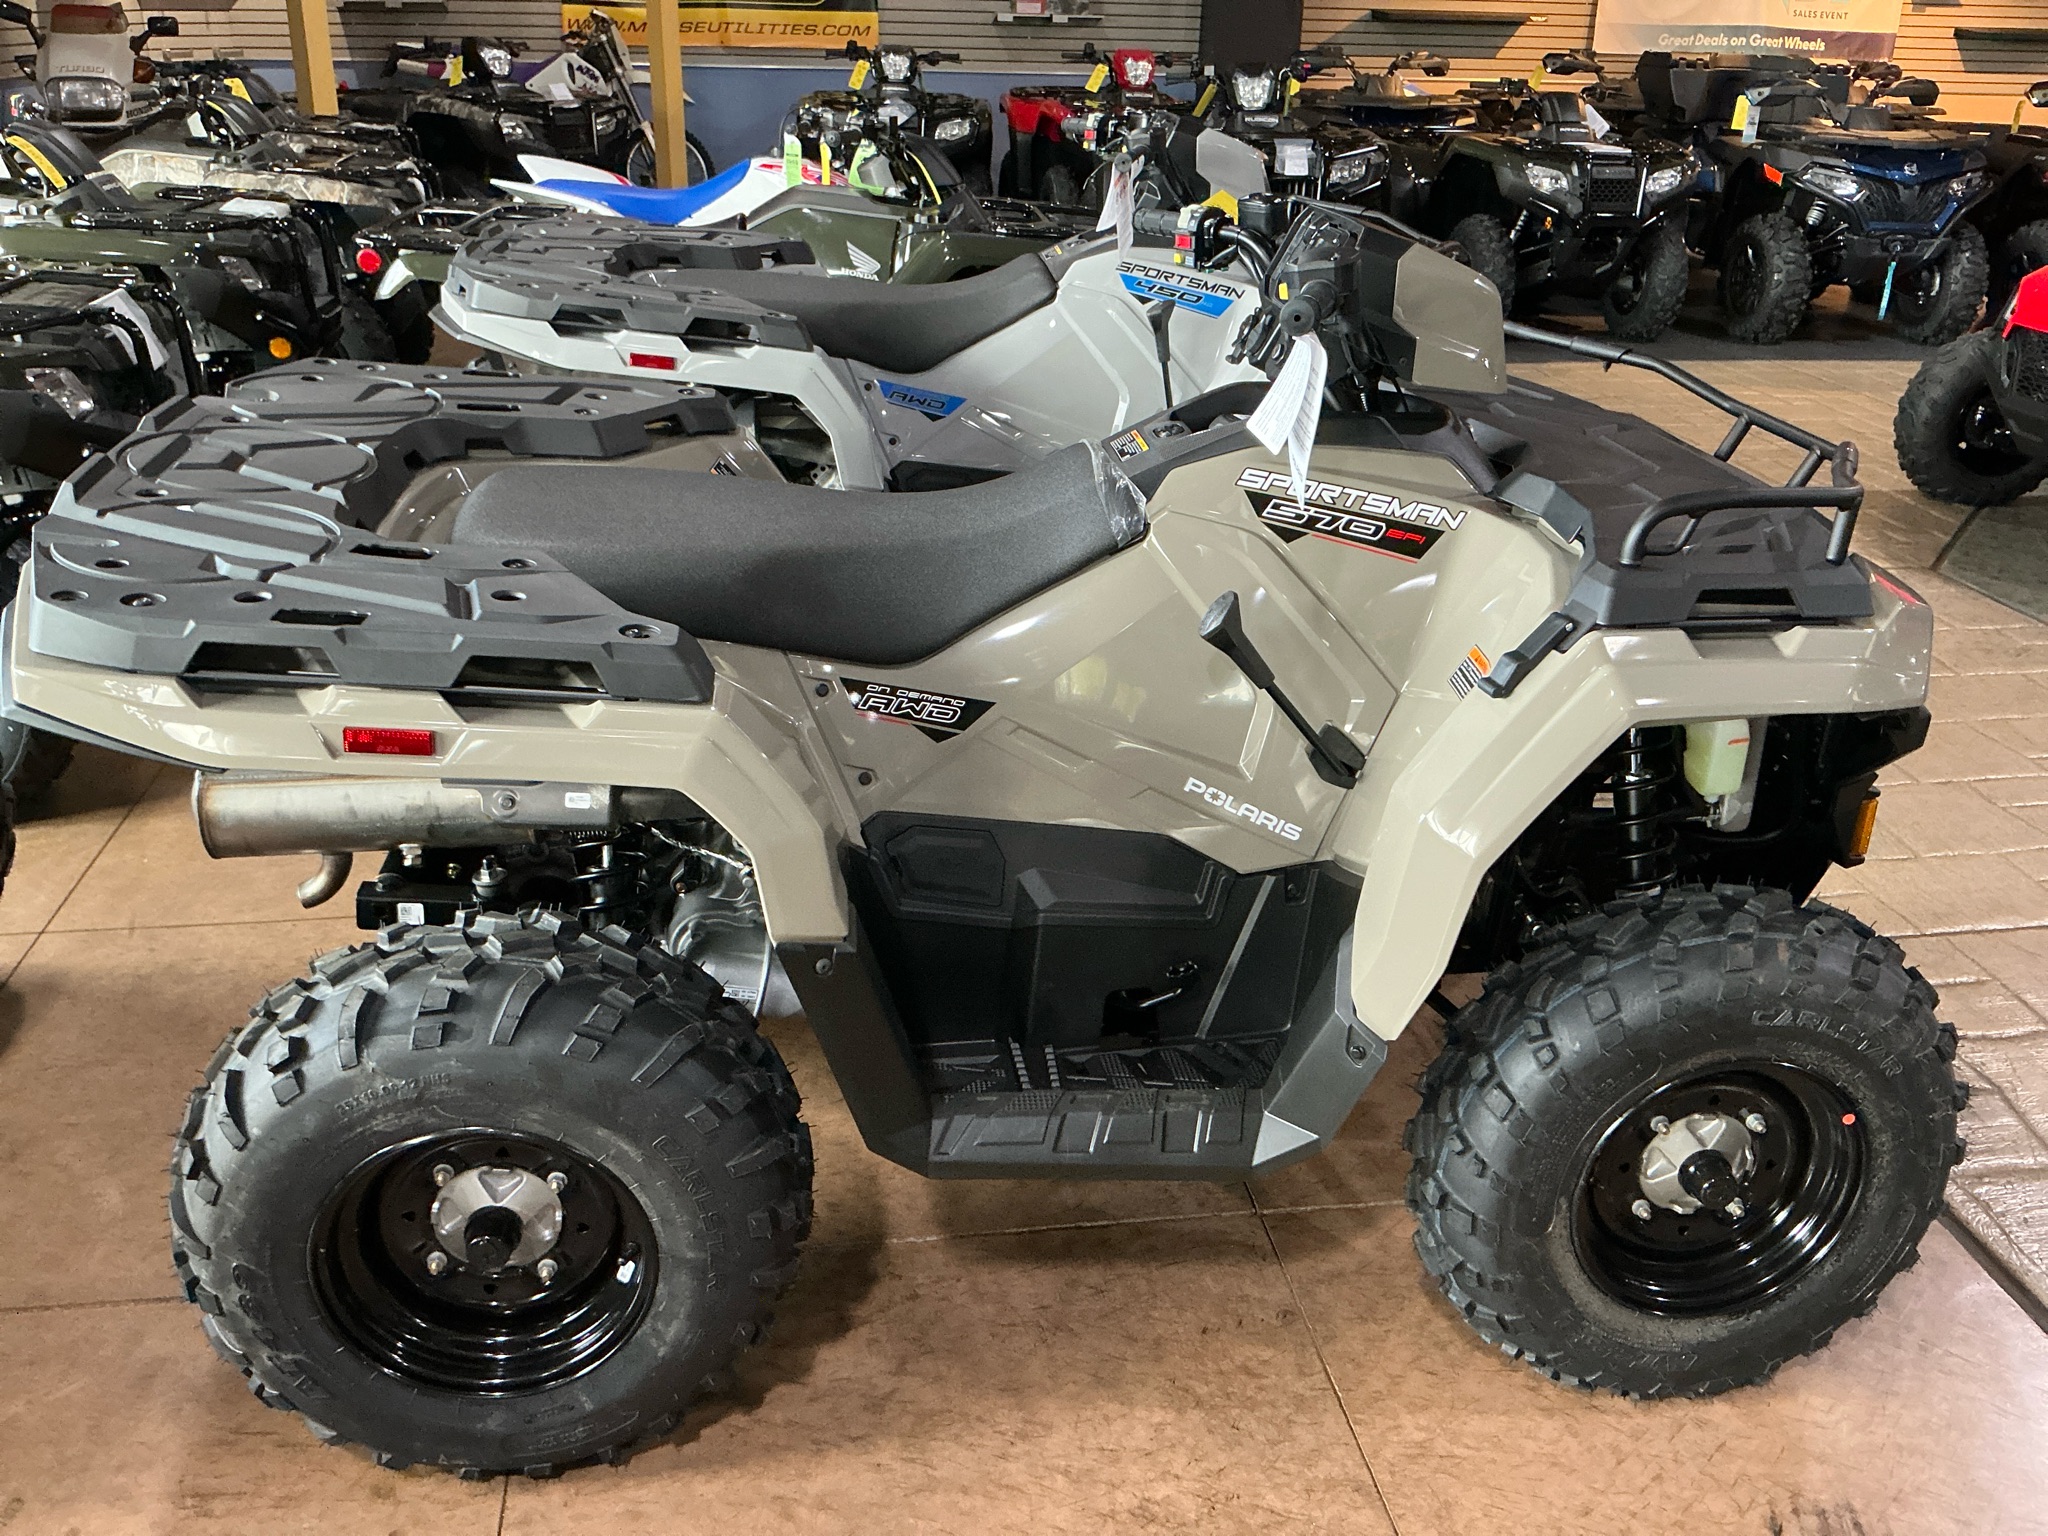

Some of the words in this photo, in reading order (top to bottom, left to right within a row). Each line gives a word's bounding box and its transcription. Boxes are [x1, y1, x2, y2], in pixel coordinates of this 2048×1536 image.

[1793, 9, 1818, 18] SALES
[1820, 11, 1848, 20] EVENT
[1658, 33, 1694, 46] Great
[1694, 33, 1729, 46] Deals
[1730, 35, 1746, 46] on
[1749, 33, 1784, 48] Great
[1784, 36, 1826, 51] Wheels
[56, 65, 105, 74] TURBO
[841, 267, 880, 281] HONDA
[1115, 261, 1246, 299] SPORTSMAN
[1135, 280, 1203, 304] 450
[889, 390, 946, 410] AWD
[1235, 467, 1467, 531] SPORTSMAN
[1261, 498, 1386, 541] 570
[1386, 528, 1426, 545] EFI
[867, 684, 890, 693] ON
[897, 690, 966, 707] DEMAND
[858, 693, 960, 723] AWD
[1183, 777, 1302, 841] POLARIS
